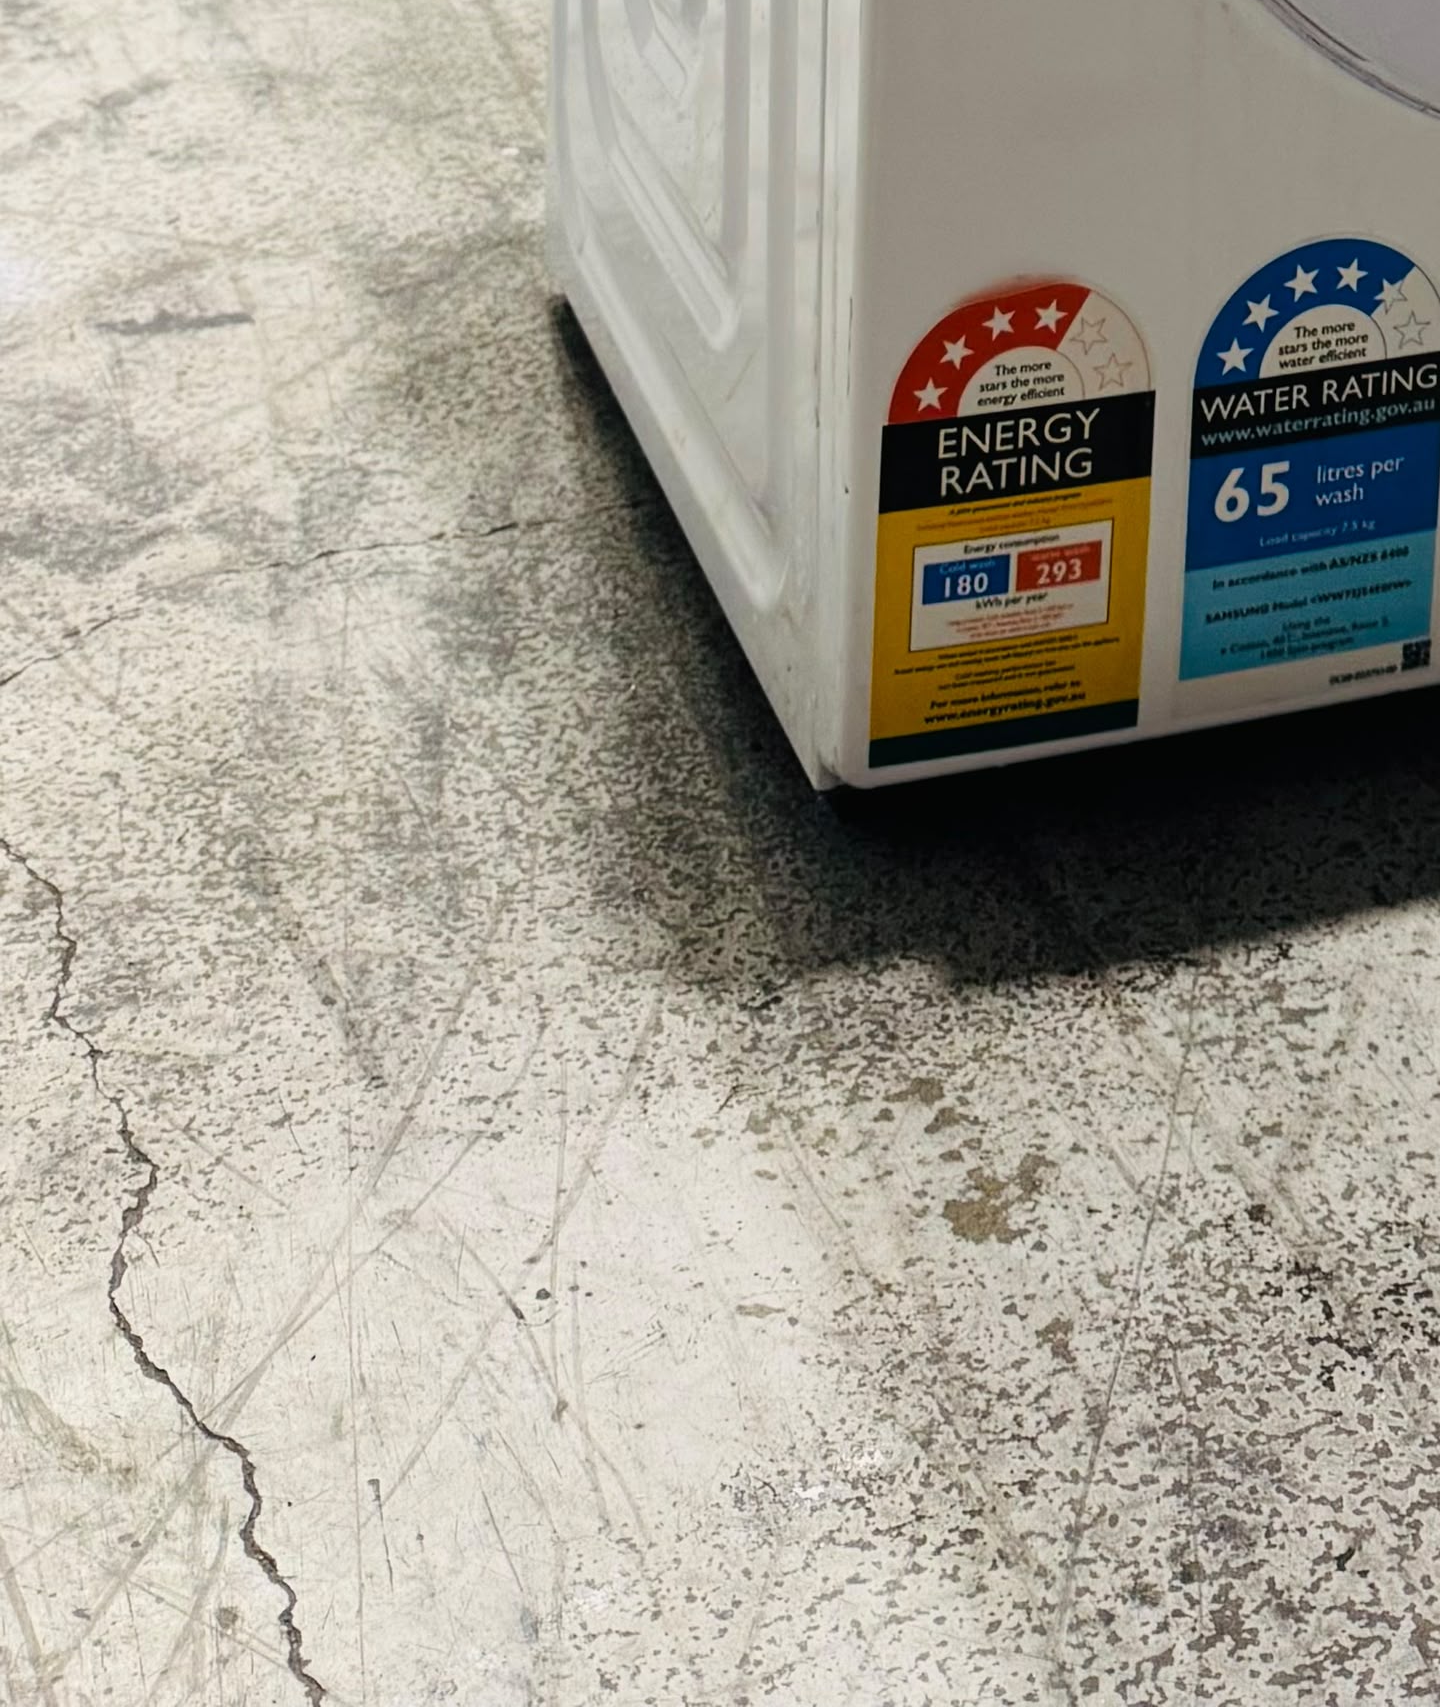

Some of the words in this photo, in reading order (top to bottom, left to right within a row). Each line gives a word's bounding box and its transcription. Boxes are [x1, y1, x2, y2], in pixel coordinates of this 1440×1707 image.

[1294, 325, 1319, 339] The
[1321, 321, 1356, 335] more
[1278, 342, 1308, 356] stars
[1311, 337, 1332, 351] the
[1335, 333, 1369, 347] more
[994, 363, 1017, 376] The
[1020, 361, 1052, 373] more
[1278, 354, 1315, 369] water
[1318, 347, 1367, 364] efficient
[979, 380, 1007, 392] stars
[1011, 376, 1030, 388] the
[1033, 373, 1065, 385] more
[1200, 384, 1311, 423] WATER
[1321, 363, 1439, 405] RATING
[977, 393, 1018, 407] energy
[1020, 387, 1065, 401] efficient
[938, 407, 1101, 459] ENERGY
[1201, 396, 1436, 447] www.waterrating.gov.au
[940, 447, 1093, 497] RATING
[1316, 463, 1365, 484] litres
[1370, 456, 1405, 481] per
[1214, 460, 1291, 523] 65
[1315, 482, 1365, 507] wash
[963, 541, 996, 555] Energy
[939, 562, 967, 575] Cold
[1036, 558, 1082, 586] 293
[943, 572, 989, 599] 180
